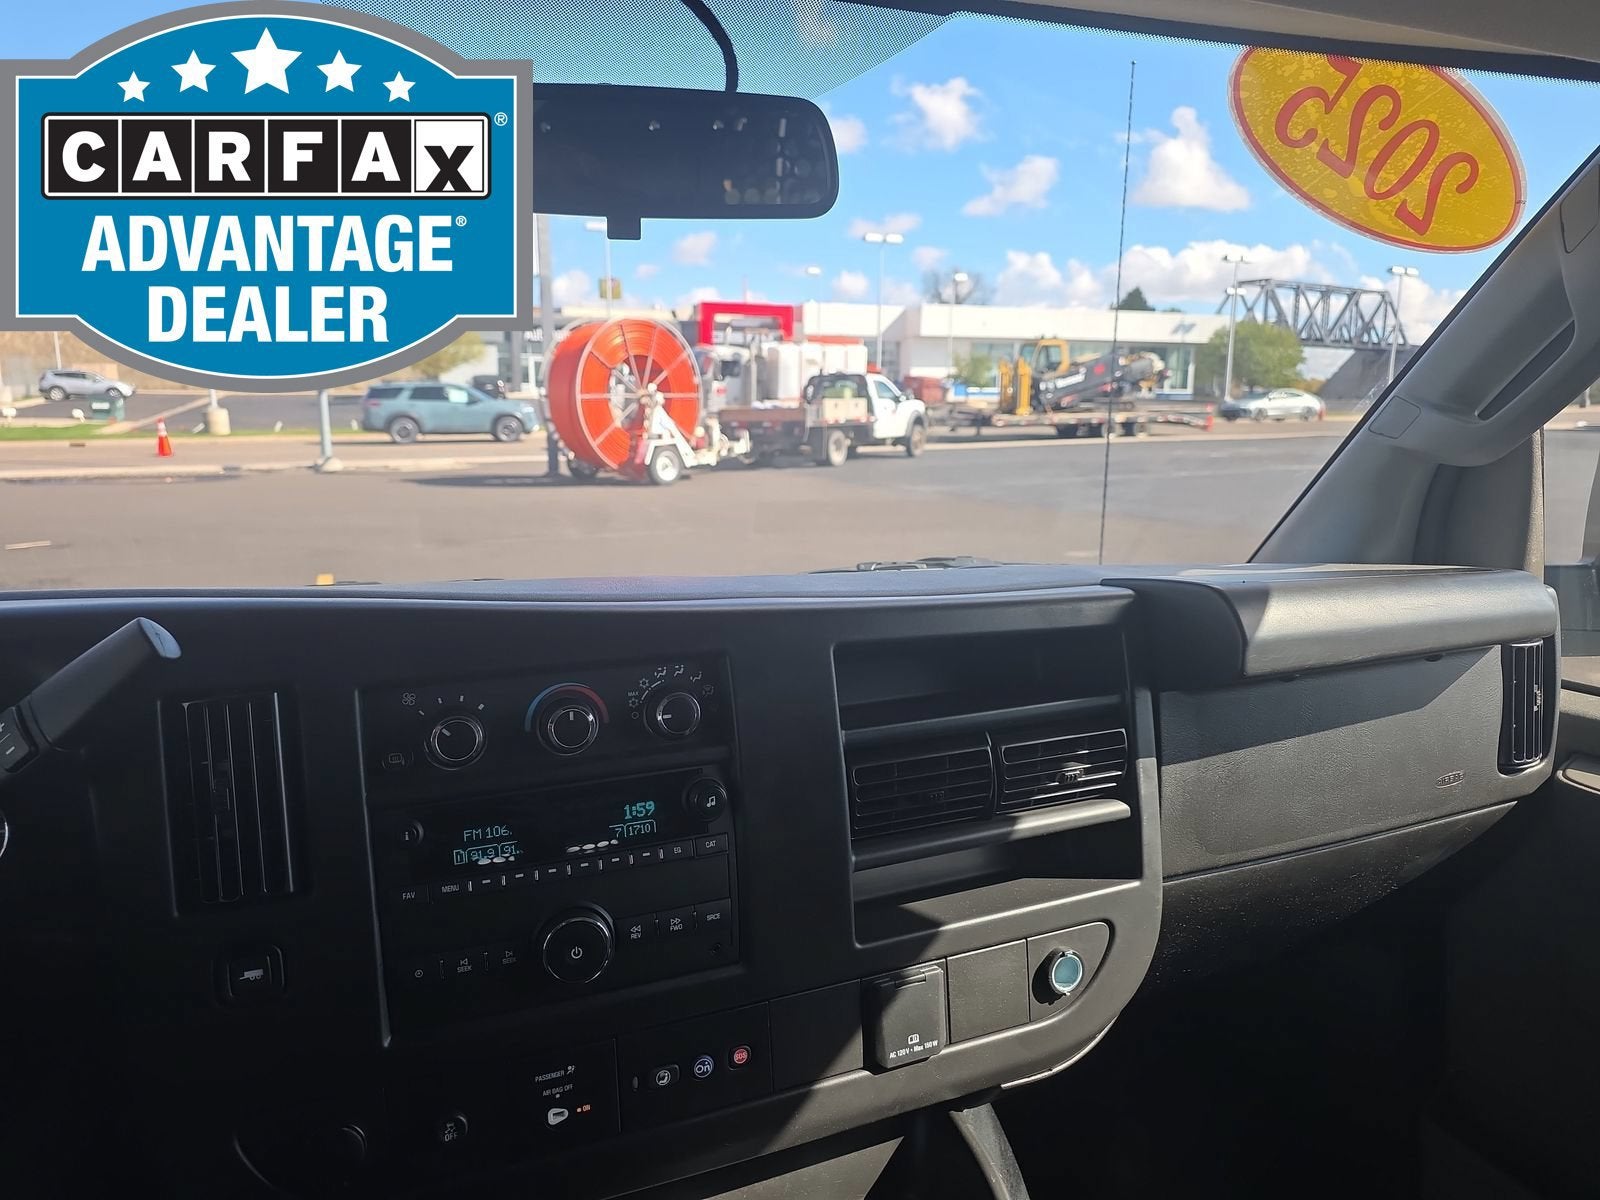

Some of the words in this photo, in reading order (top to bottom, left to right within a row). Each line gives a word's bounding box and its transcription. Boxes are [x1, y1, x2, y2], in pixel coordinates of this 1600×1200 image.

[624, 800, 656, 820] 1:59
[628, 823, 651, 836] 1710
[463, 829, 482, 842] FM
[705, 840, 717, 849] CAT
[441, 884, 460, 894] MENU
[402, 891, 416, 901] FAV
[630, 932, 642, 940] REV
[502, 957, 517, 965] SEEK
[456, 964, 472, 973] SEEK
[534, 1069, 565, 1083] PASSENGER
[582, 1104, 591, 1112] ON
[444, 1131, 457, 1142] OFF
